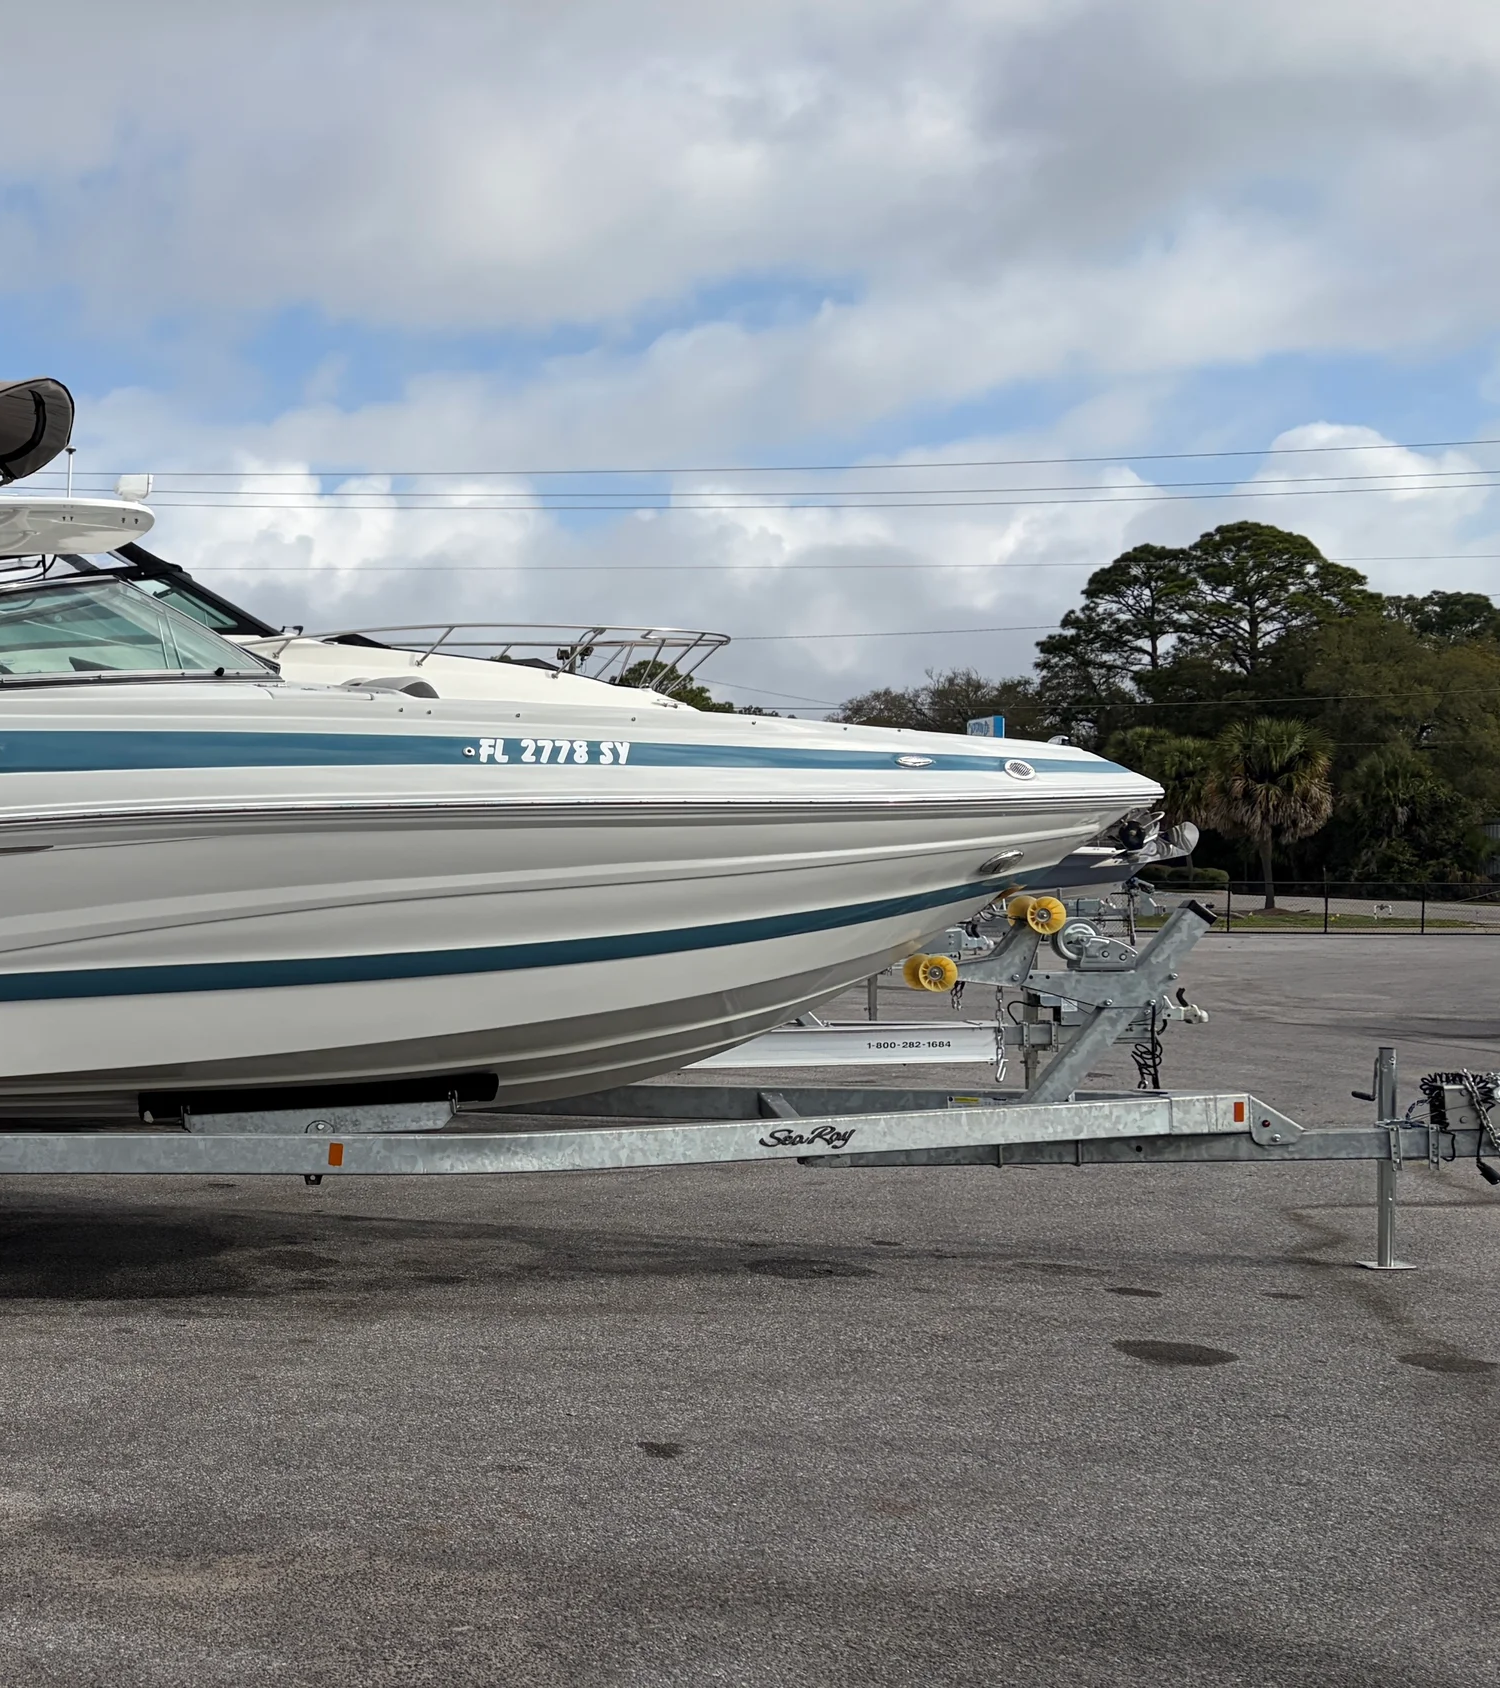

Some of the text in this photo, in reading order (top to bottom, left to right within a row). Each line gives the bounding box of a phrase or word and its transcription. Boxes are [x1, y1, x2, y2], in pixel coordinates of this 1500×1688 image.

[479, 739, 631, 765] FL 2778 SY
[866, 1041, 952, 1049] 1-800-282-1684
[759, 1125, 856, 1149] Sea Ray
